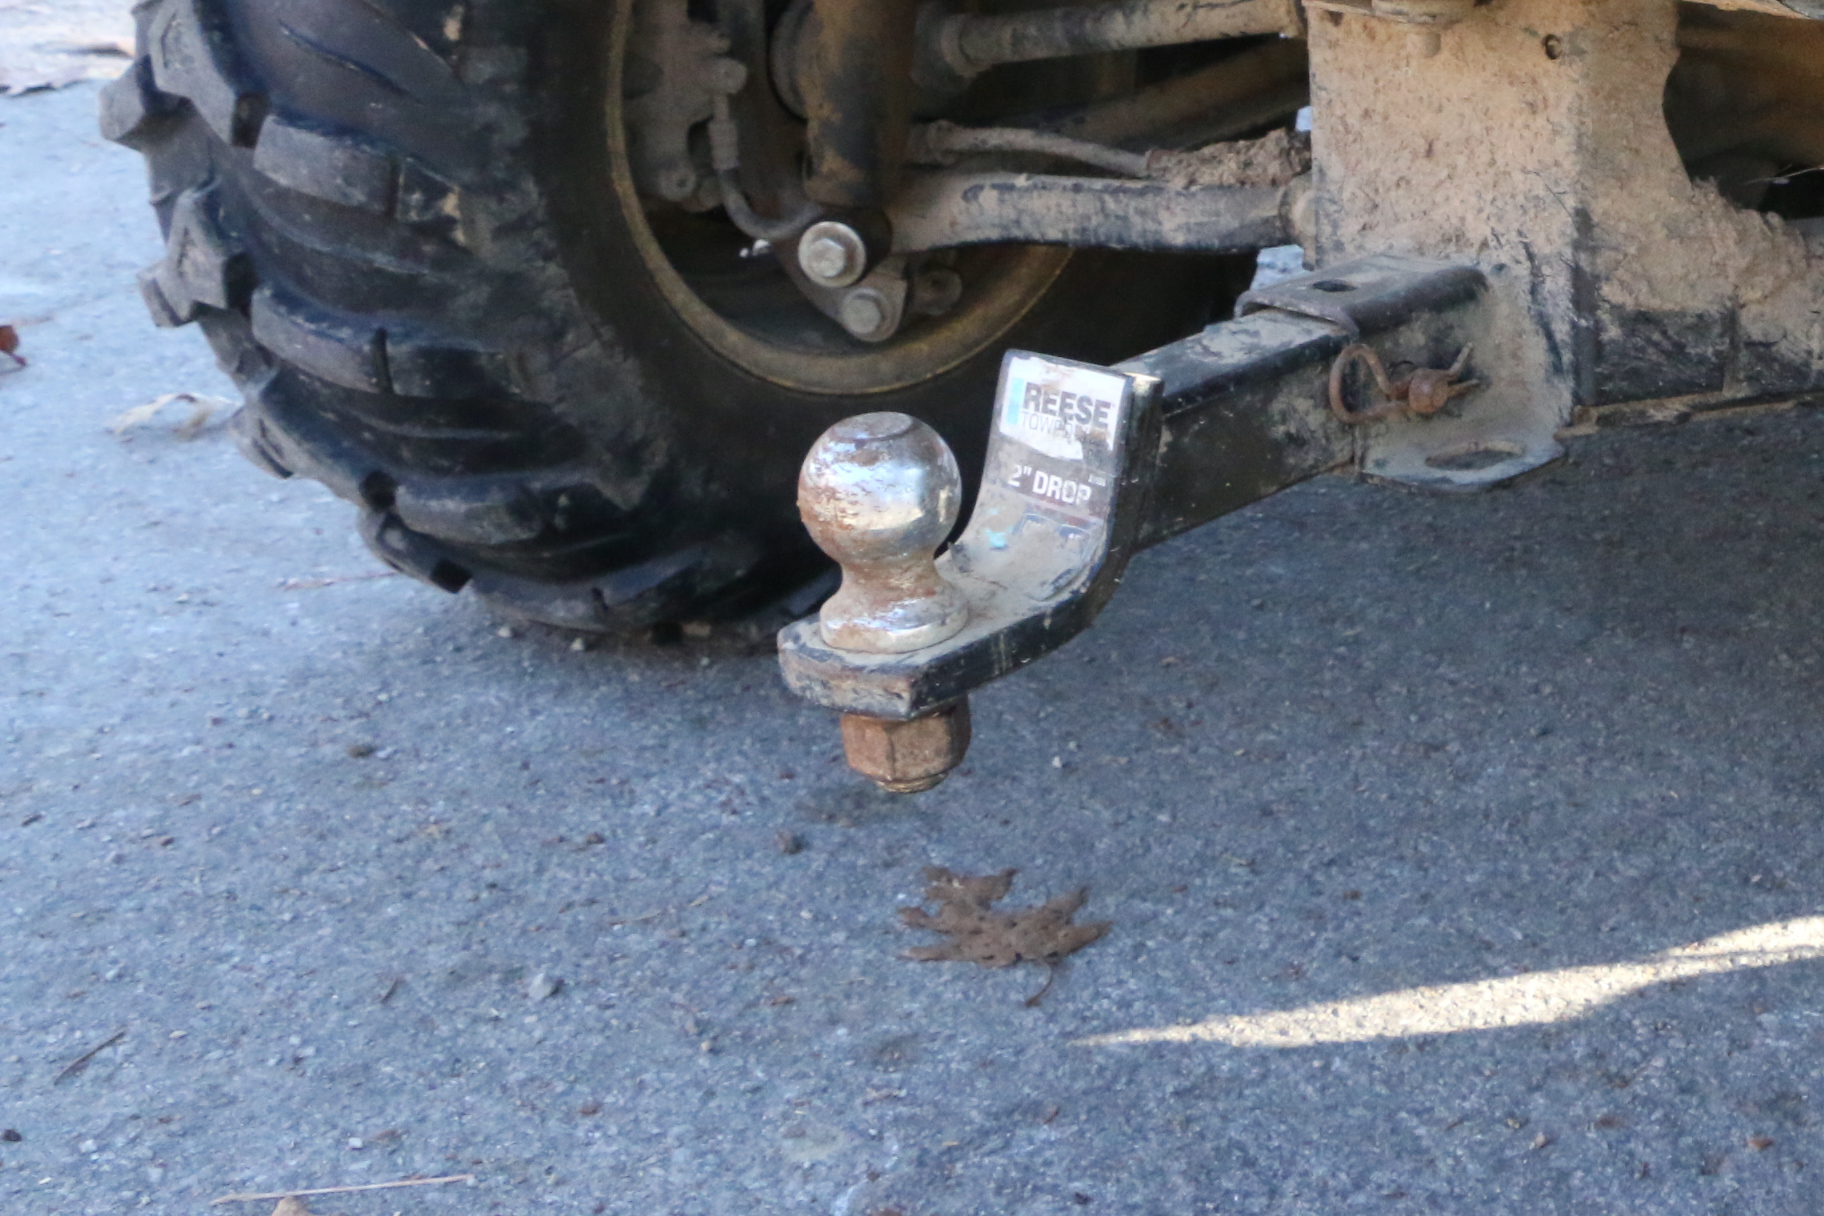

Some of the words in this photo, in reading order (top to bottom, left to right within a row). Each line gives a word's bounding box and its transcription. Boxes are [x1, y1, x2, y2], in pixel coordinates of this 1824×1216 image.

[1023, 381, 1112, 429] REESE
[1007, 464, 1032, 488] 2"
[1032, 470, 1092, 505] DROP
